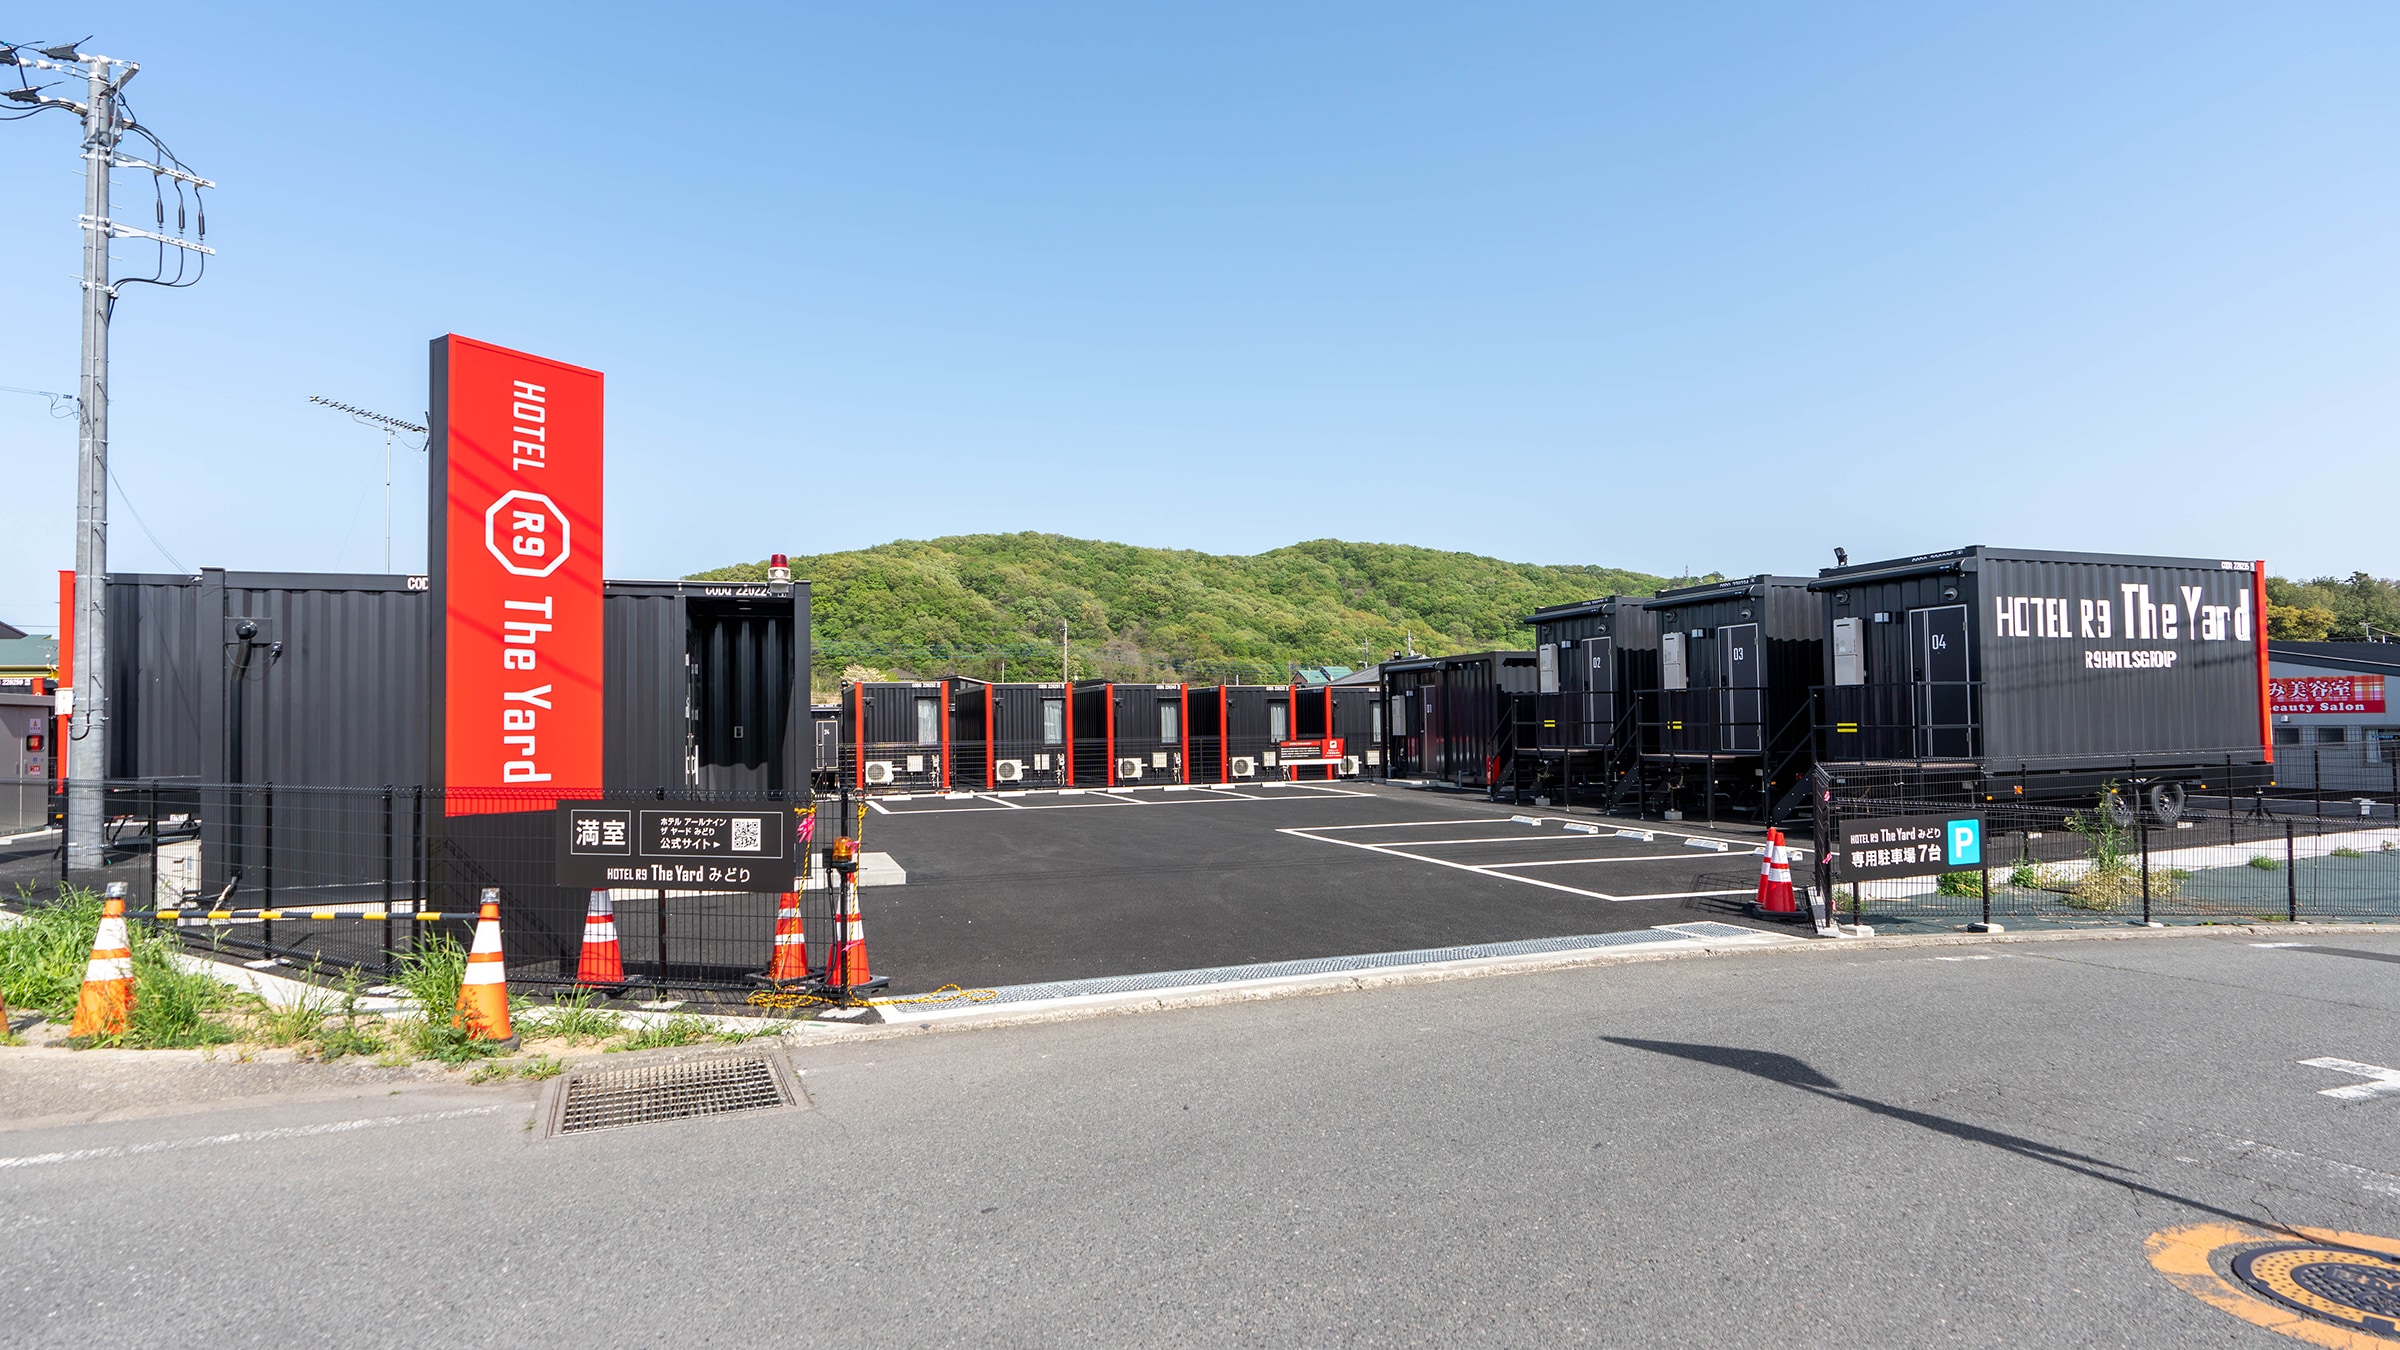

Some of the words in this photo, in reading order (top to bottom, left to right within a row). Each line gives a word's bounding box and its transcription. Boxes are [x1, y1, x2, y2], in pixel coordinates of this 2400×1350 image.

[513, 380, 546, 471] HOTEL
[512, 510, 546, 557] R9
[1996, 596, 2072, 638] HOTEL
[2080, 598, 2111, 638] R9
[2120, 583, 2178, 640] The
[2180, 585, 2251, 641] Yard
[504, 596, 552, 670] The
[1932, 634, 1947, 650] 04
[1592, 656, 1601, 668] 02
[1733, 647, 1744, 660] 03
[2270, 703, 2315, 713] eauty
[2320, 702, 2365, 711] Salon
[503, 684, 552, 783] Yard
[660, 817, 682, 826] ホテル
[684, 817, 727, 827] アールナイン
[660, 826, 669, 836] ザ
[670, 826, 692, 836] ヤード
[694, 827, 715, 836] みどり
[576, 819, 626, 846] 満室
[1850, 833, 1870, 845] HOTEL
[1870, 832, 1879, 843] R9
[1880, 828, 1897, 842] The
[1896, 826, 1916, 841] Yard
[1917, 827, 1941, 840] みどり
[660, 837, 711, 850] 公式サイト
[1954, 827, 1974, 858] P
[607, 868, 635, 880] HOTEL
[635, 868, 648, 881] R9
[650, 864, 673, 881] The
[674, 864, 704, 882] Yard
[708, 867, 751, 883] みどり
